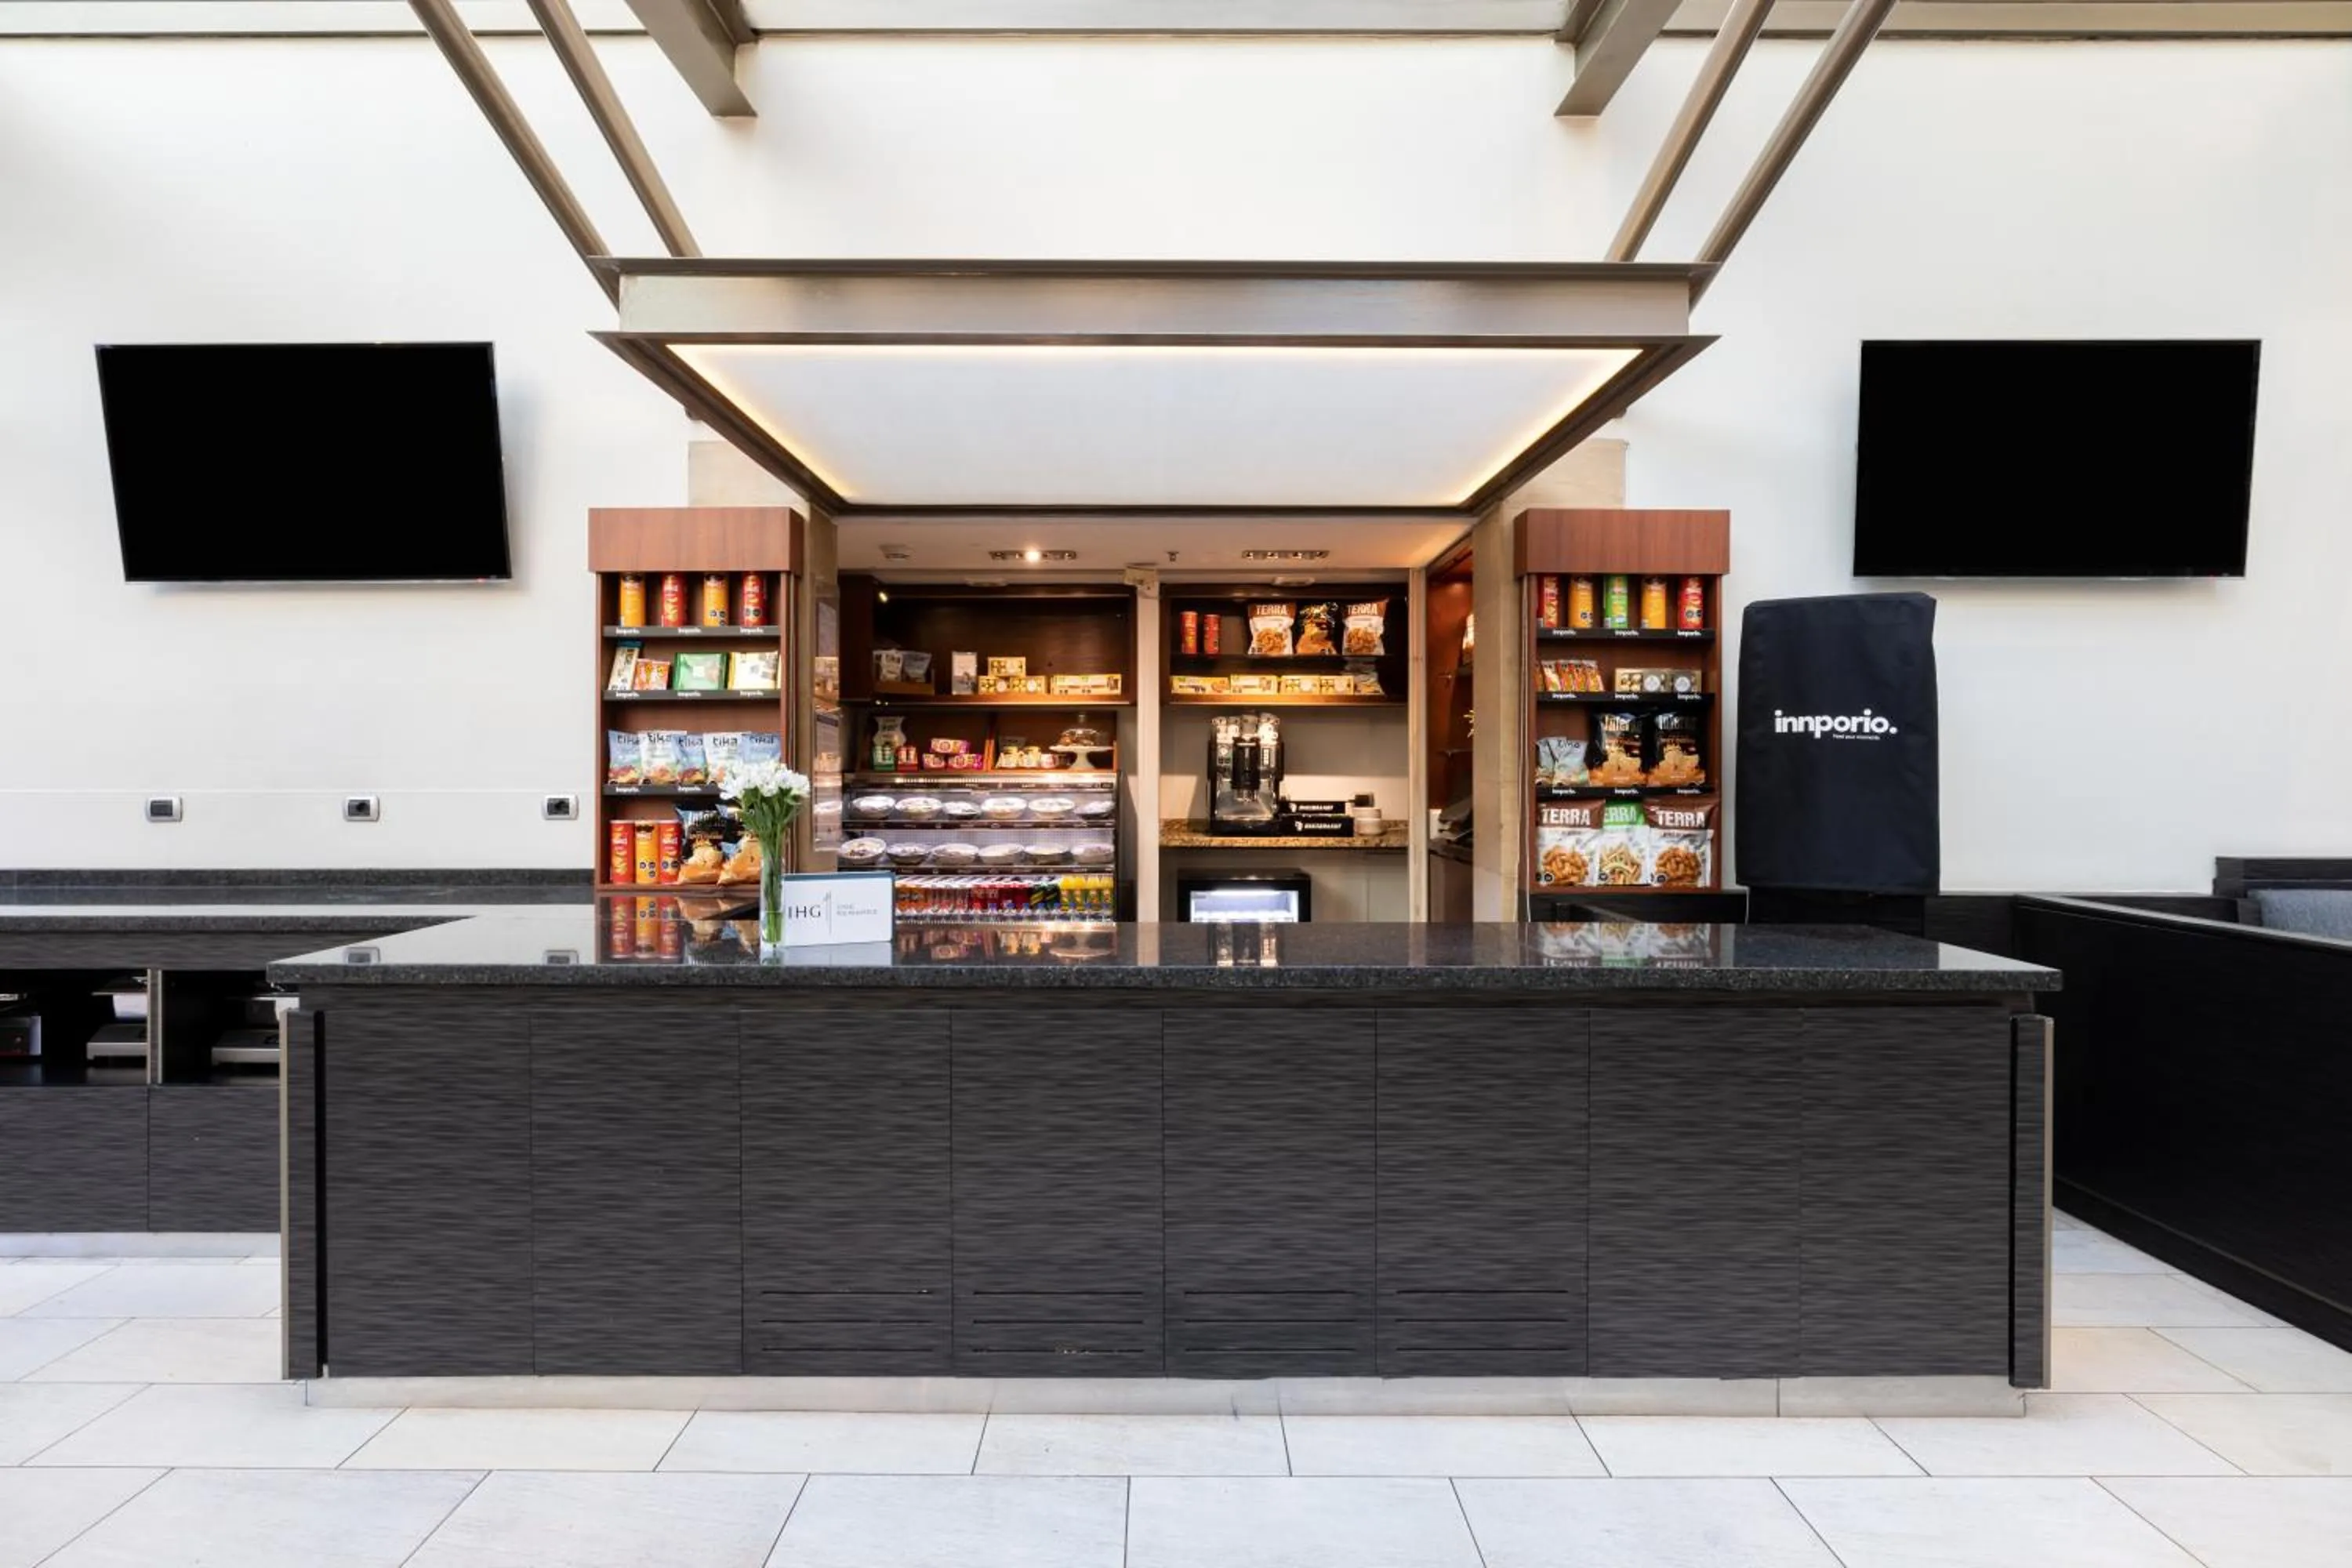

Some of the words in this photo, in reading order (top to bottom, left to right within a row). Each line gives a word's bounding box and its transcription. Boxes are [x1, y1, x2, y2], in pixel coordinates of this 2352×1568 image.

[1256, 604, 1287, 615] TERRA
[1347, 603, 1377, 615] TERRA
[1774, 709, 1898, 739] innporio.
[1541, 808, 1591, 826] TERRA
[1603, 805, 1637, 823] ERRA
[1655, 810, 1706, 827] TERRA
[788, 905, 821, 919] IHG
